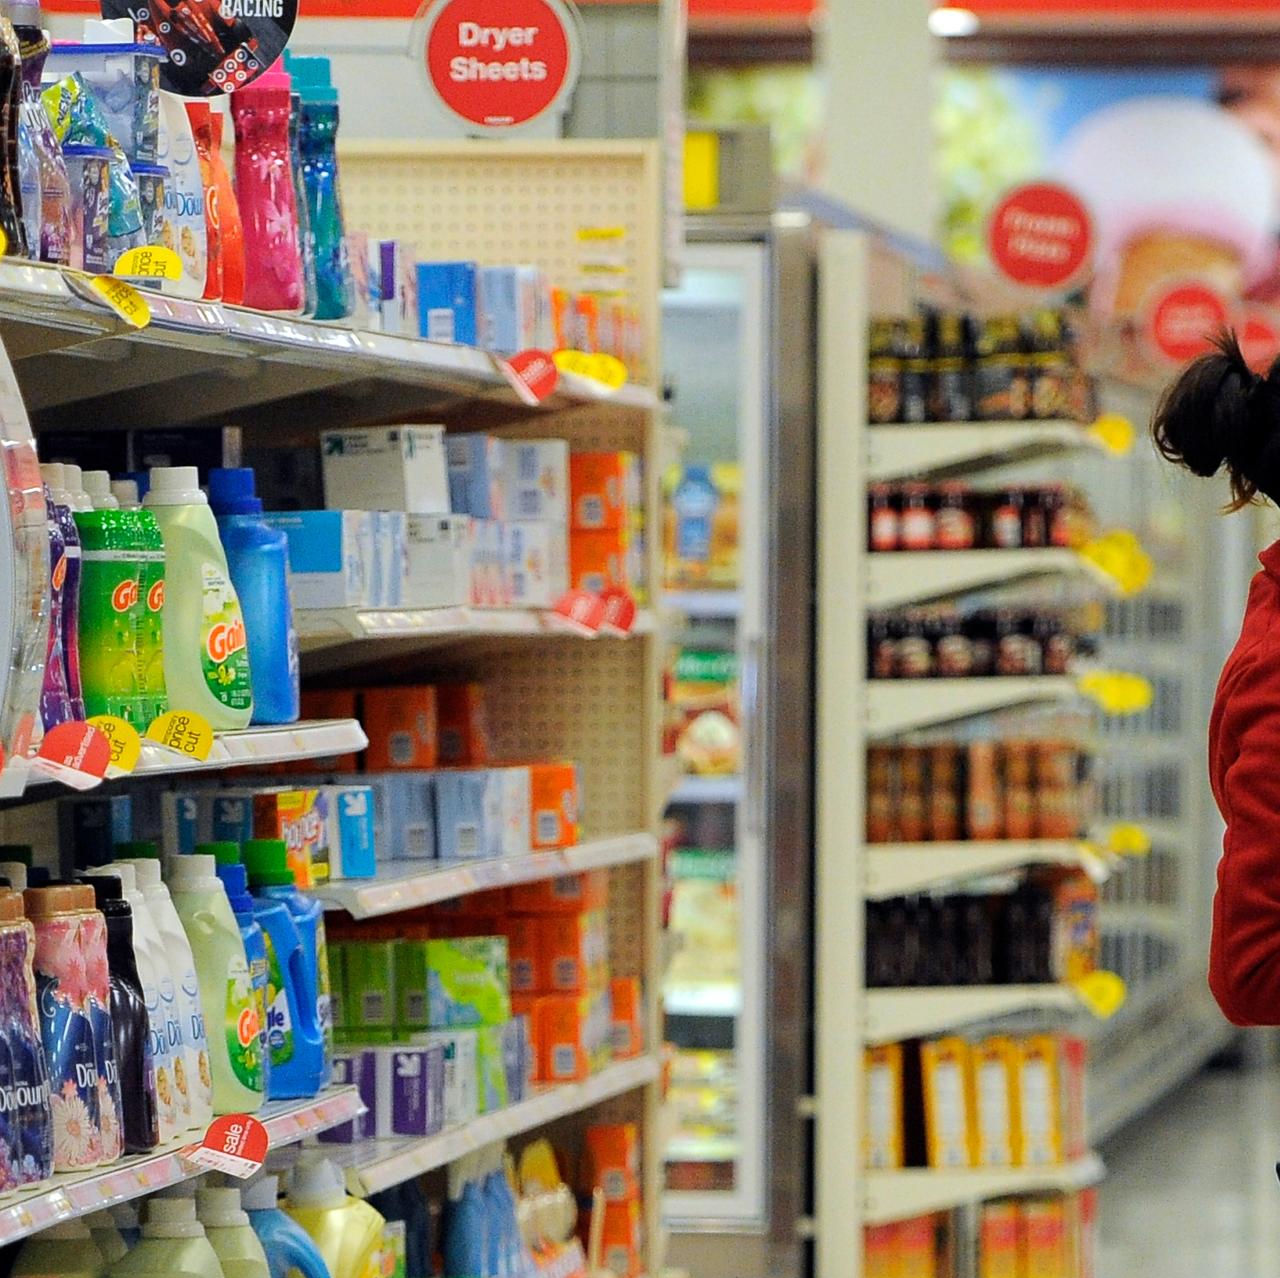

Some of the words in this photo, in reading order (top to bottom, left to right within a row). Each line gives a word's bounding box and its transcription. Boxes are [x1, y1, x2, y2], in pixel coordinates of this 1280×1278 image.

[221, 0, 283, 18] RACING
[458, 22, 540, 51] Dryer
[449, 56, 548, 82] Sheets
[170, 715, 190, 750] price
[184, 731, 201, 753] cut
[112, 739, 127, 762] cut
[223, 1123, 243, 1154] sale
